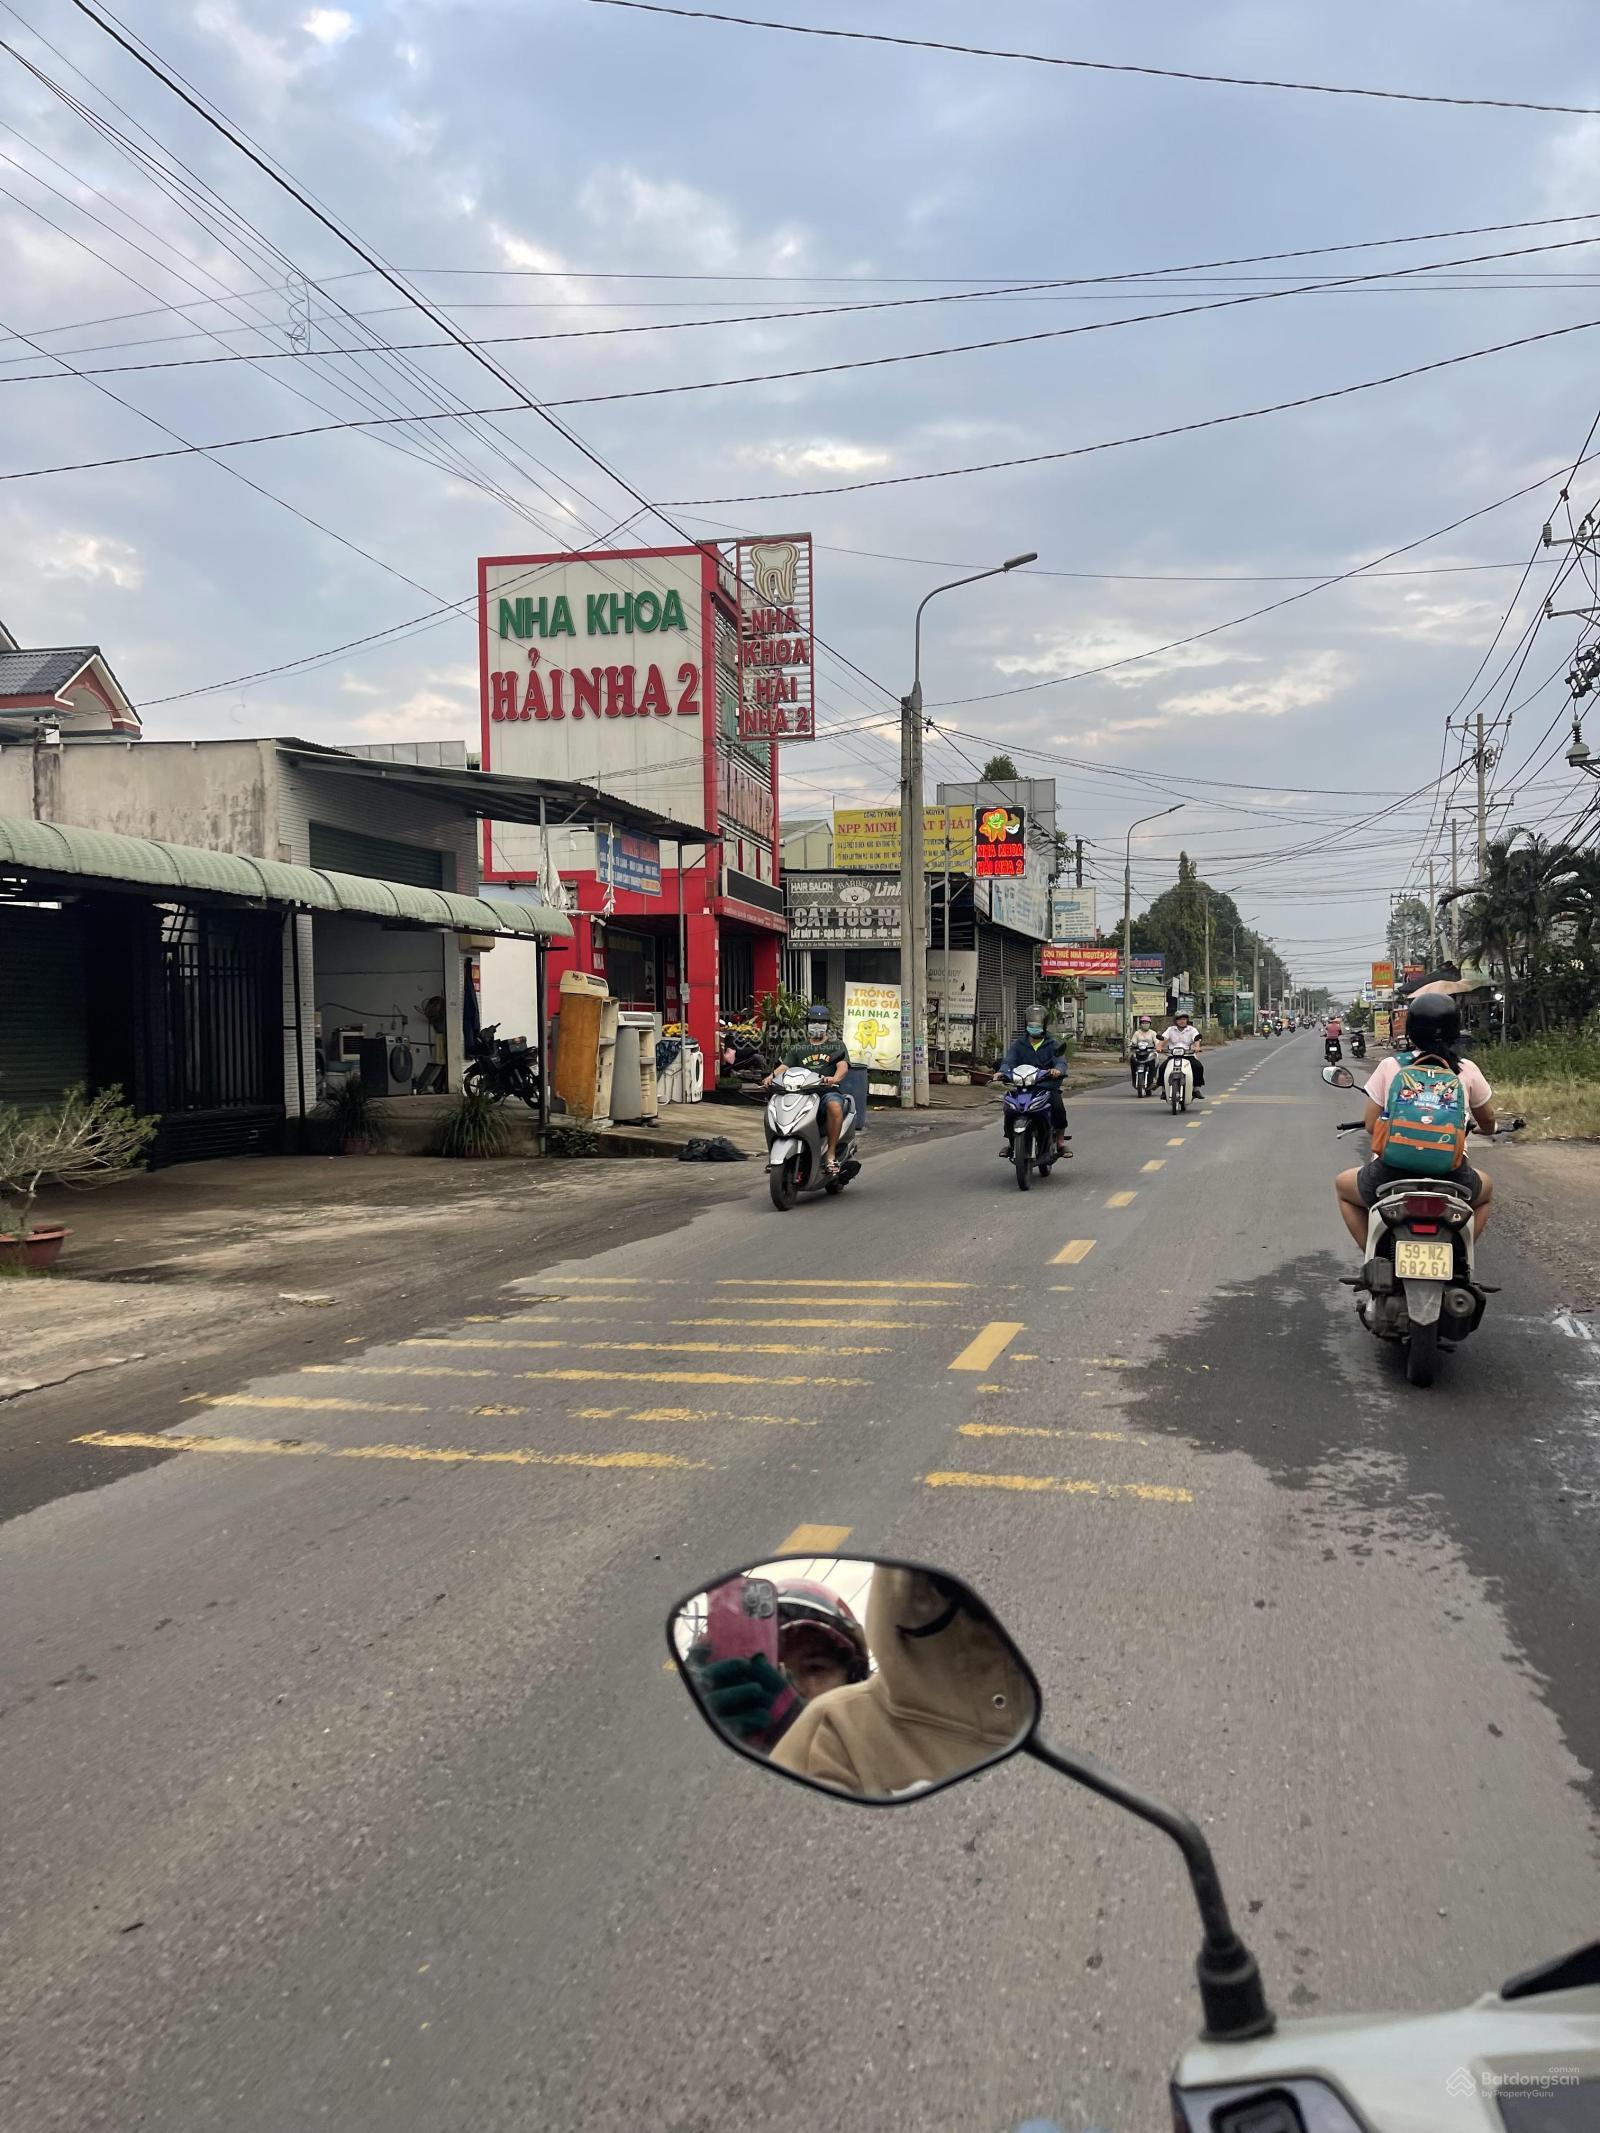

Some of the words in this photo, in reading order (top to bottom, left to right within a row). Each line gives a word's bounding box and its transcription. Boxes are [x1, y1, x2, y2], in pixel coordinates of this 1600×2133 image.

[500, 595, 577, 638] NHA
[587, 589, 688, 635] KHOA
[751, 607, 798, 633] NHA
[743, 638, 809, 668] KHOA
[490, 647, 566, 721] HẢI
[570, 662, 672, 719] NHA
[676, 662, 700, 715] 2
[743, 707, 790, 734] NHA
[796, 706, 809, 732] 2
[837, 823, 861, 834] NPP
[864, 821, 897, 833] MINH
[977, 844, 997, 858] NHA
[998, 843, 1023, 857] KHOA
[995, 860, 1015, 875] NHA
[1016, 859, 1024, 874] 2
[791, 882, 808, 892] HAIR
[809, 881, 833, 891] SALON
[868, 1009, 890, 1019] NHA
[893, 1012, 899, 1020] 2
[1404, 1244, 1444, 1261] 59-N2
